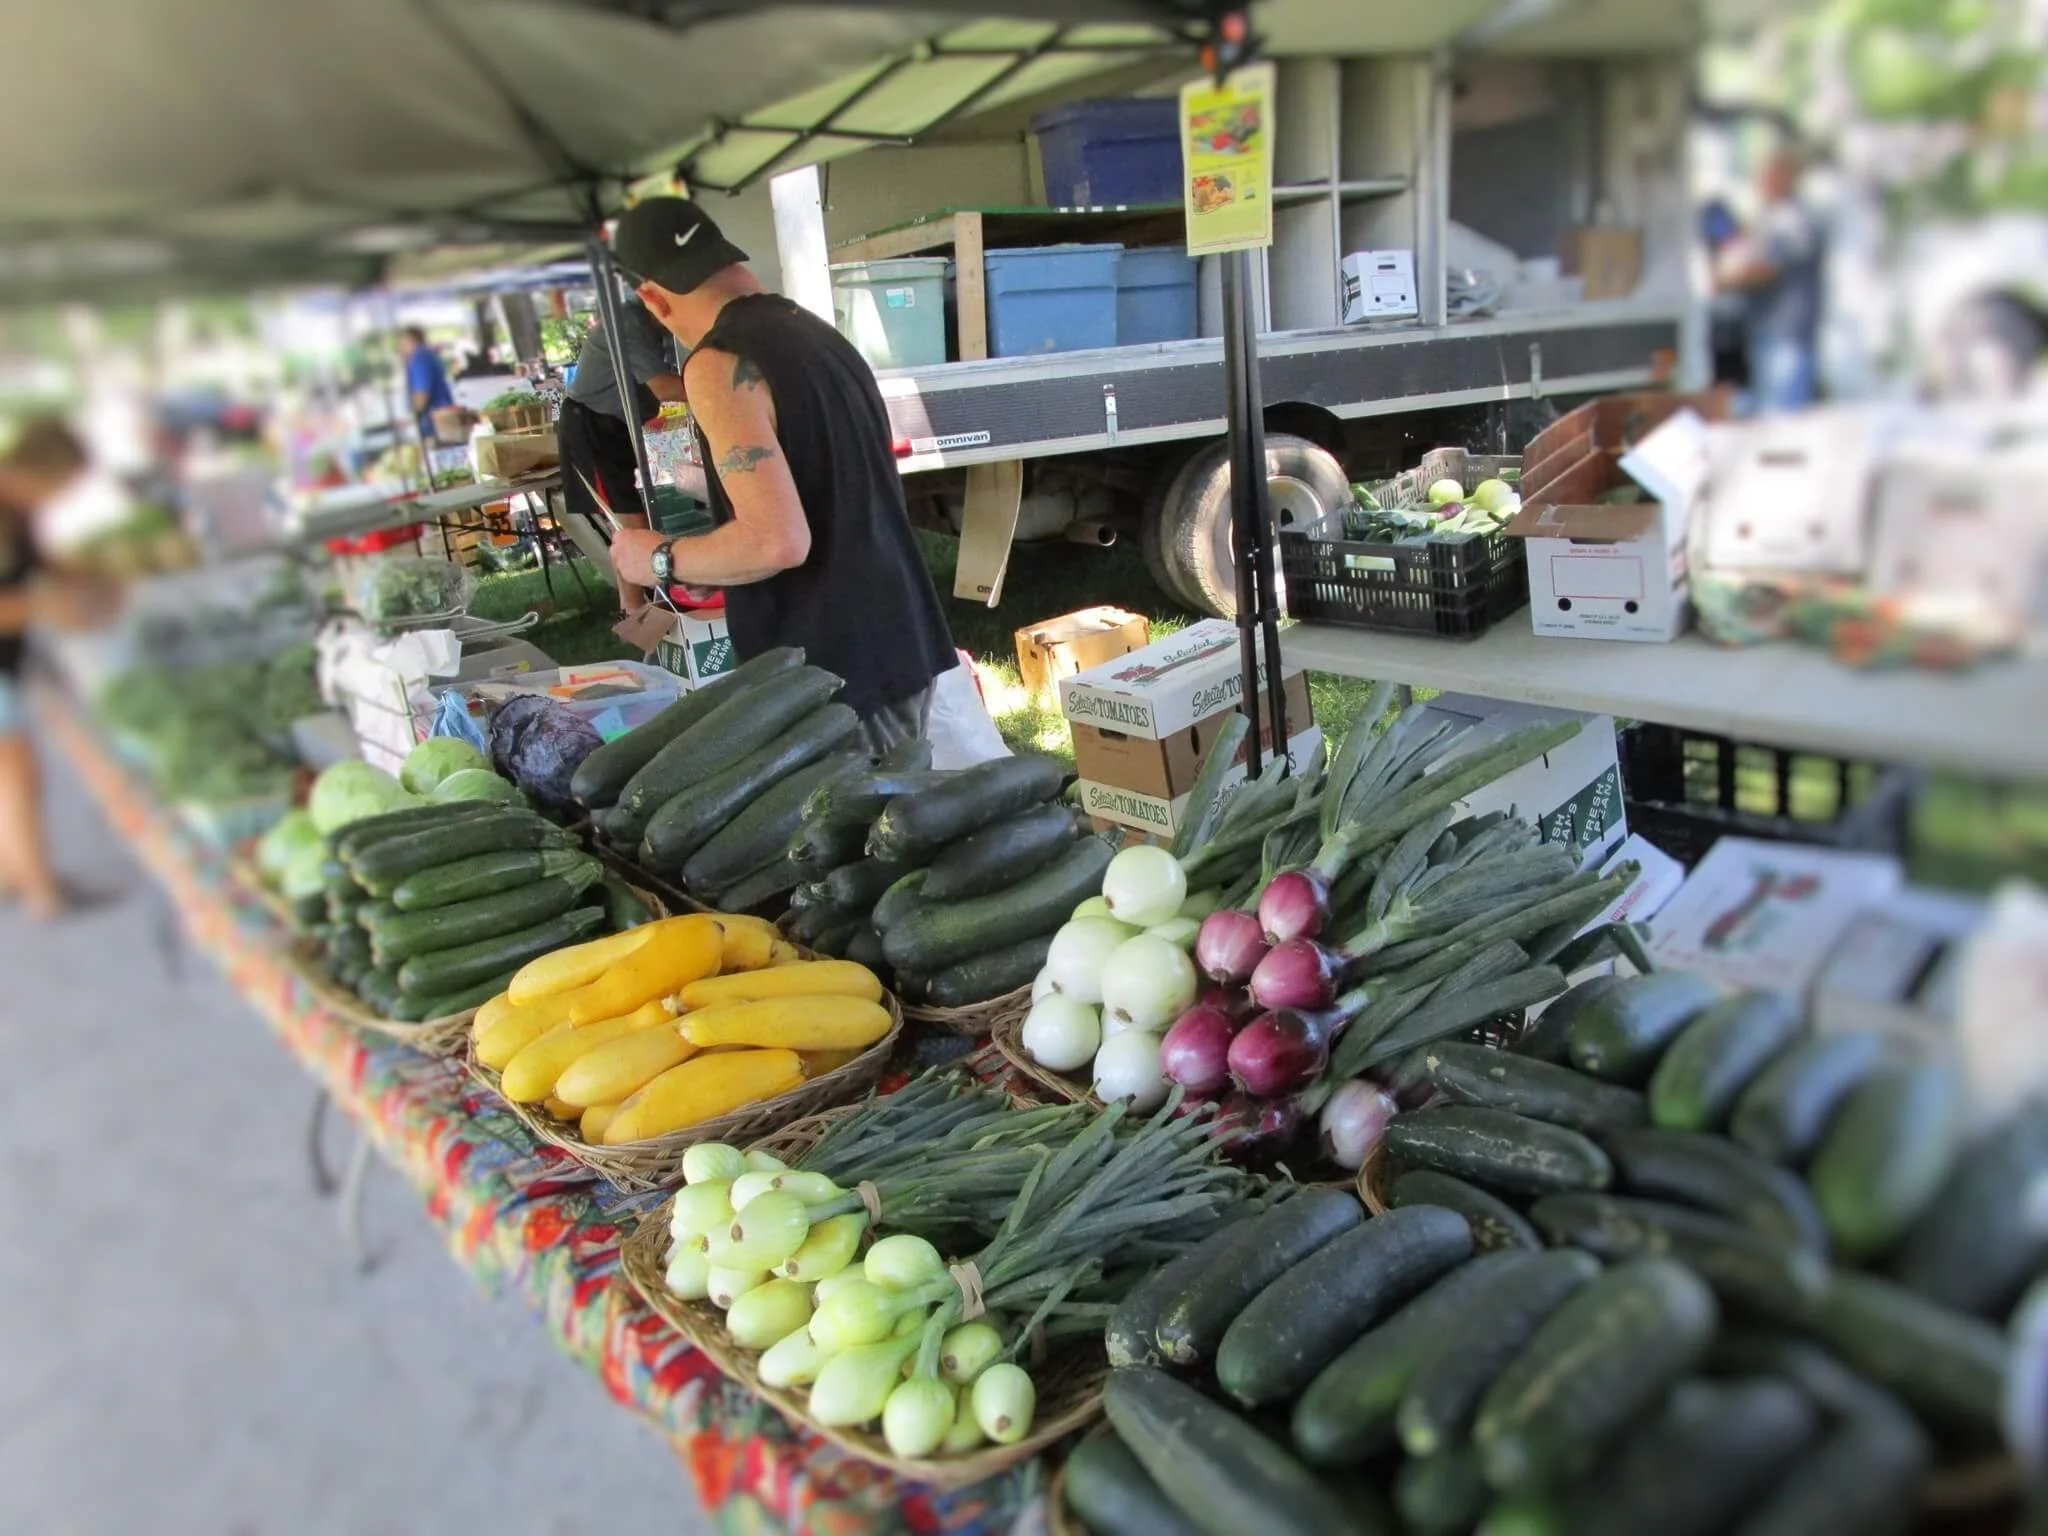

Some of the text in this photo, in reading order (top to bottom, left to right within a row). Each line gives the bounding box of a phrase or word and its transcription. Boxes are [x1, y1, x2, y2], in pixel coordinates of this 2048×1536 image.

[936, 433, 989, 446] omnivan
[700, 641, 722, 674] FRESH
[711, 638, 732, 672] BEANS
[1069, 691, 1150, 728] Selected TOMATOES
[1192, 679, 1228, 718] Selected
[1090, 787, 1169, 826] Selected TOMATOES
[1582, 783, 1605, 842] FRESH
